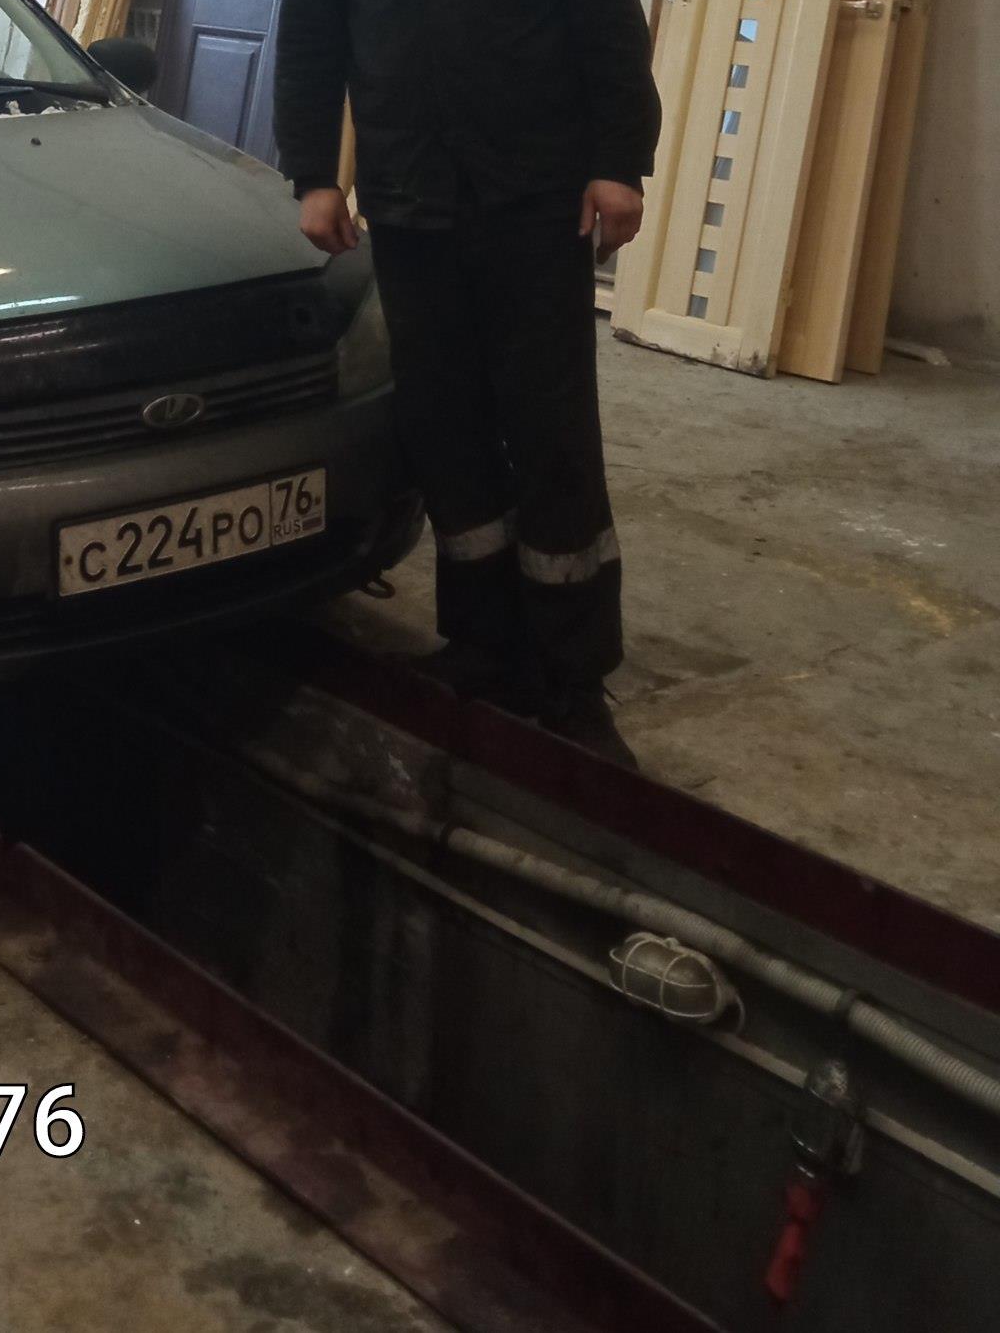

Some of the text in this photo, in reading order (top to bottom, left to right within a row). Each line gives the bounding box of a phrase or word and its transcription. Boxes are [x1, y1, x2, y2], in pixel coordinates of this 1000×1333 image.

[79, 476, 312, 583] С224РО 76
[273, 519, 301, 537] RUS
